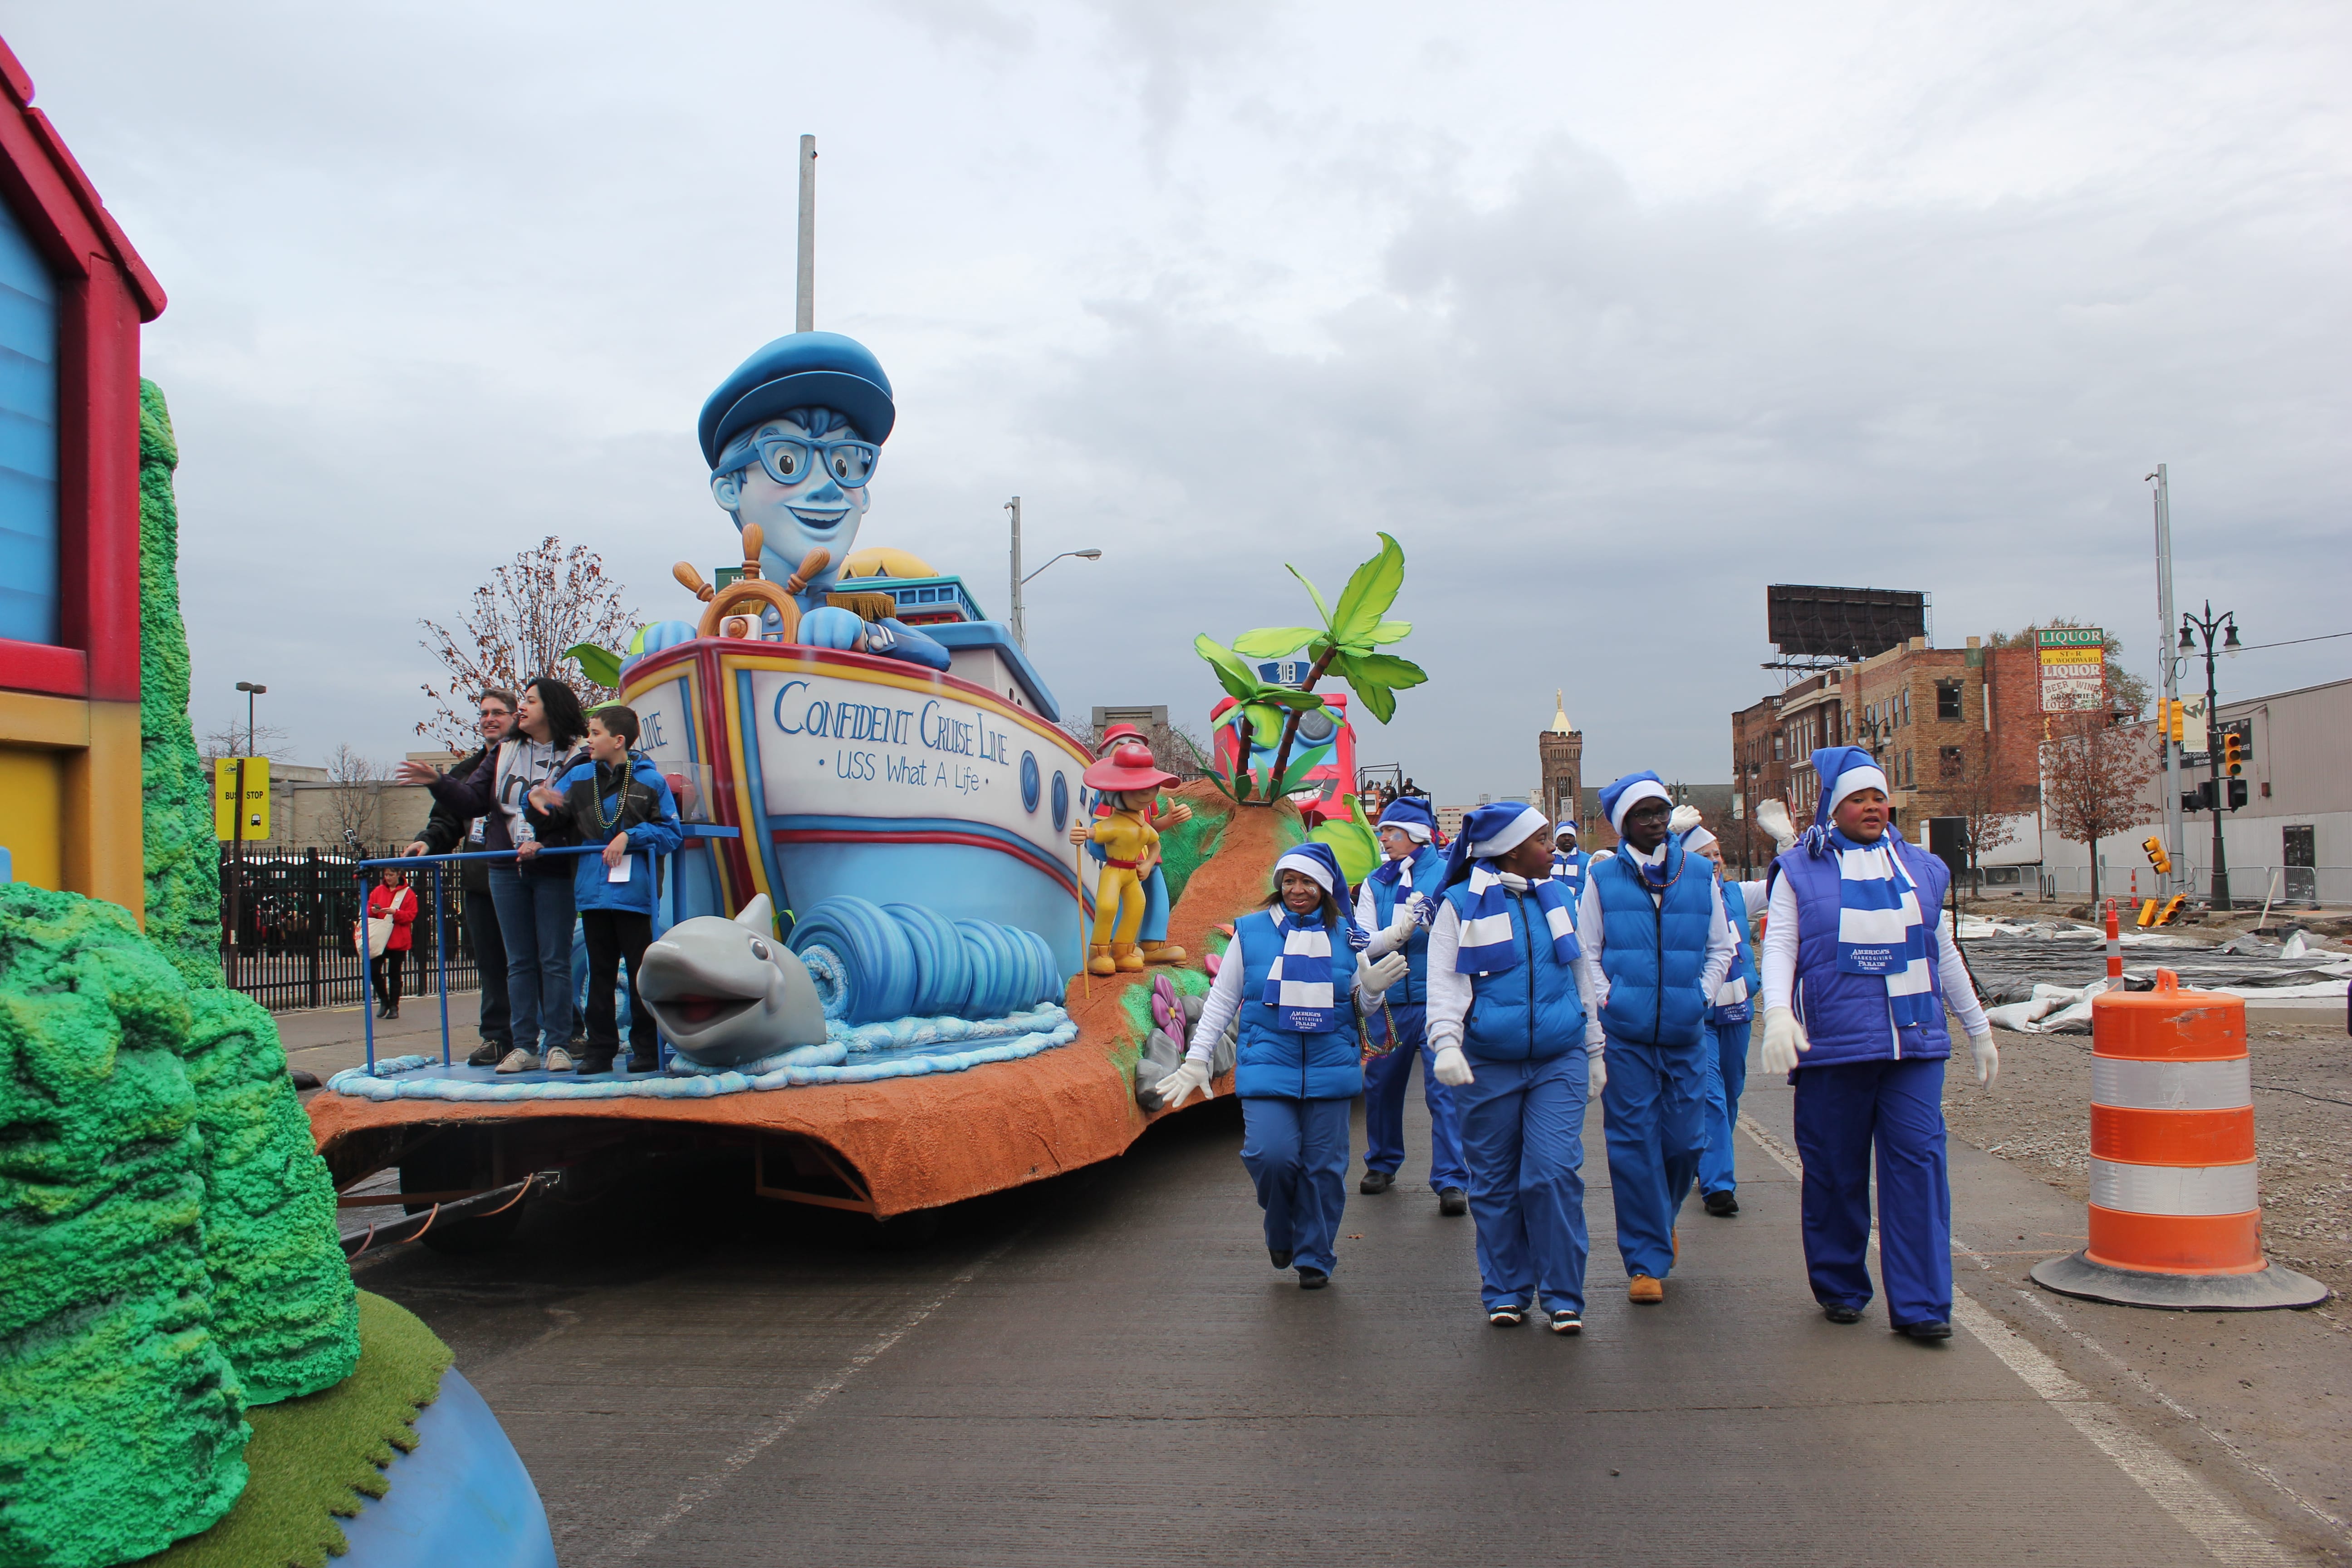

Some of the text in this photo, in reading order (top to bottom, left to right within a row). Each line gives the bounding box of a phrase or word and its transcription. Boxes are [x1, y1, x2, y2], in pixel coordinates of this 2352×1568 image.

[2040, 631, 2101, 645] LIQUOR
[2043, 664, 2100, 678] LIQUOR
[2044, 681, 2100, 694] BEER WINE
[774, 681, 1009, 766] CONFIDENT CRUISE LINE
[837, 750, 980, 795] USS What A Life
